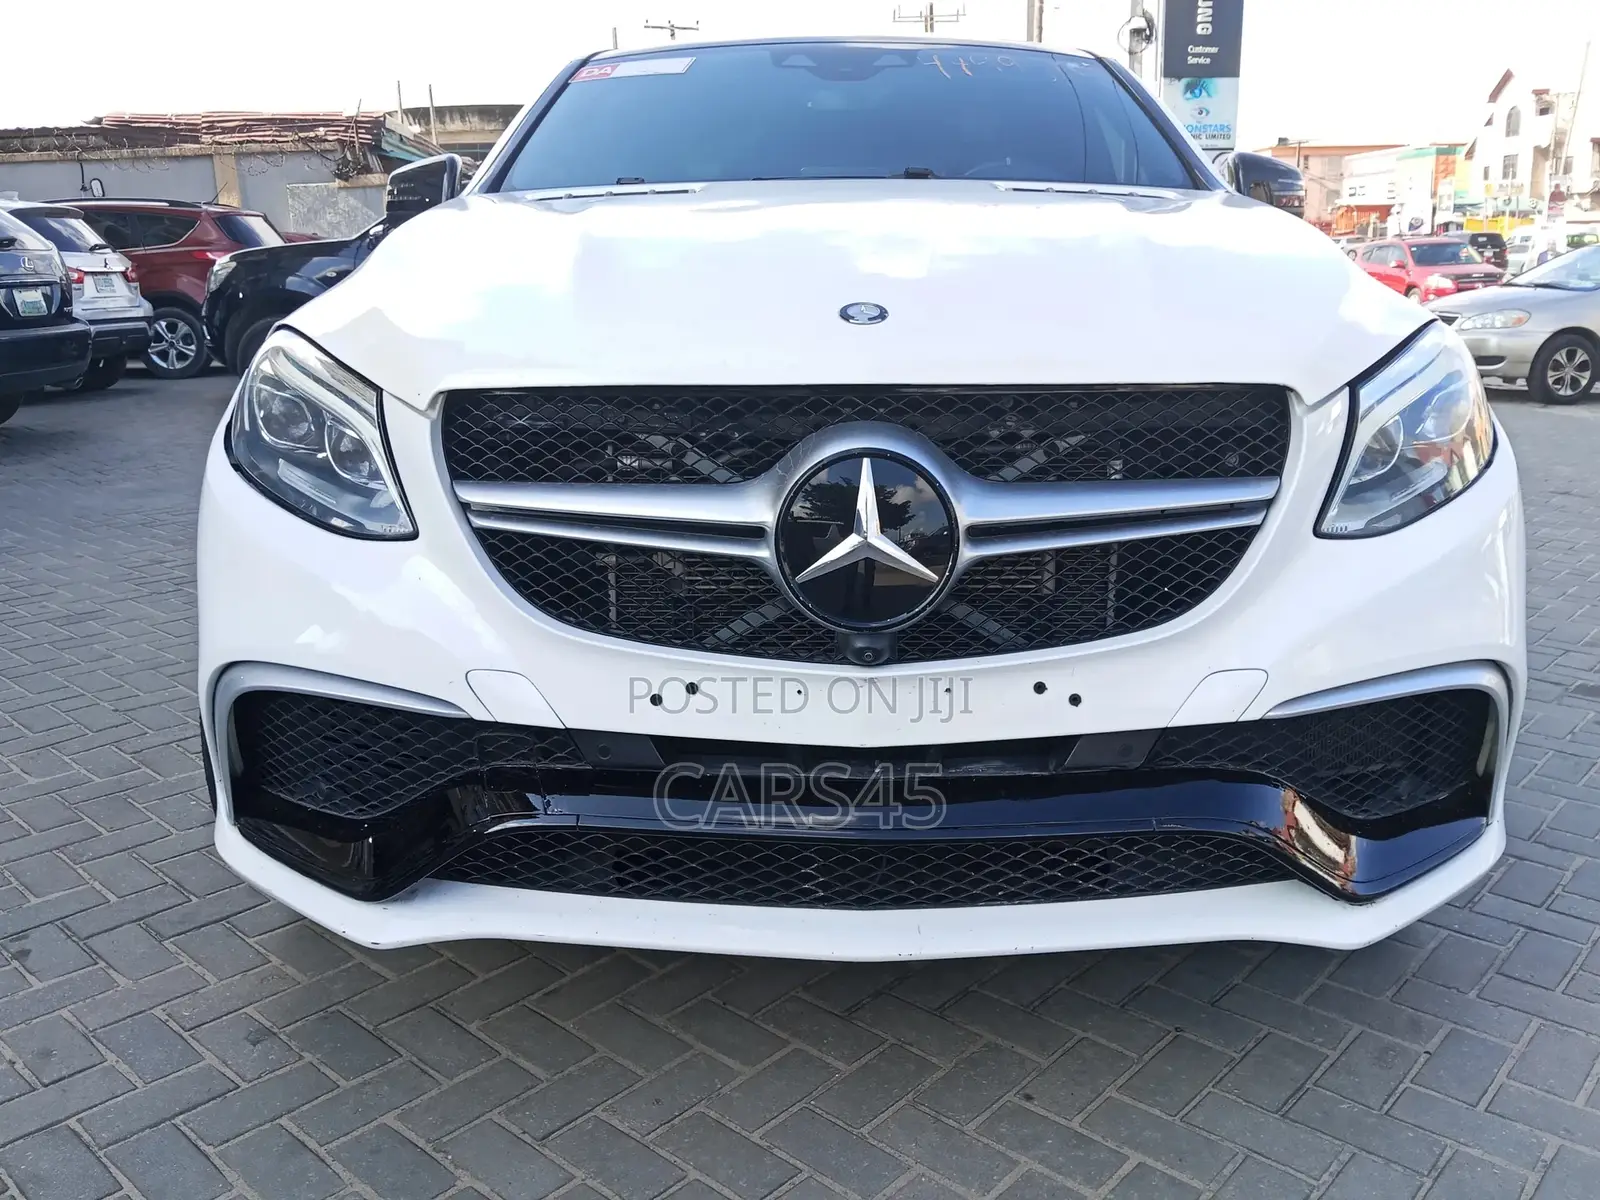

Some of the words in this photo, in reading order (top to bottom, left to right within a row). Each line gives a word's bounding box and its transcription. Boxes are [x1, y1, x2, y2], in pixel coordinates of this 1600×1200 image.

[1188, 45, 1219, 54] Customer
[1187, 56, 1211, 65] Service
[583, 66, 612, 78] DA
[1184, 124, 1232, 134] ONSTARS
